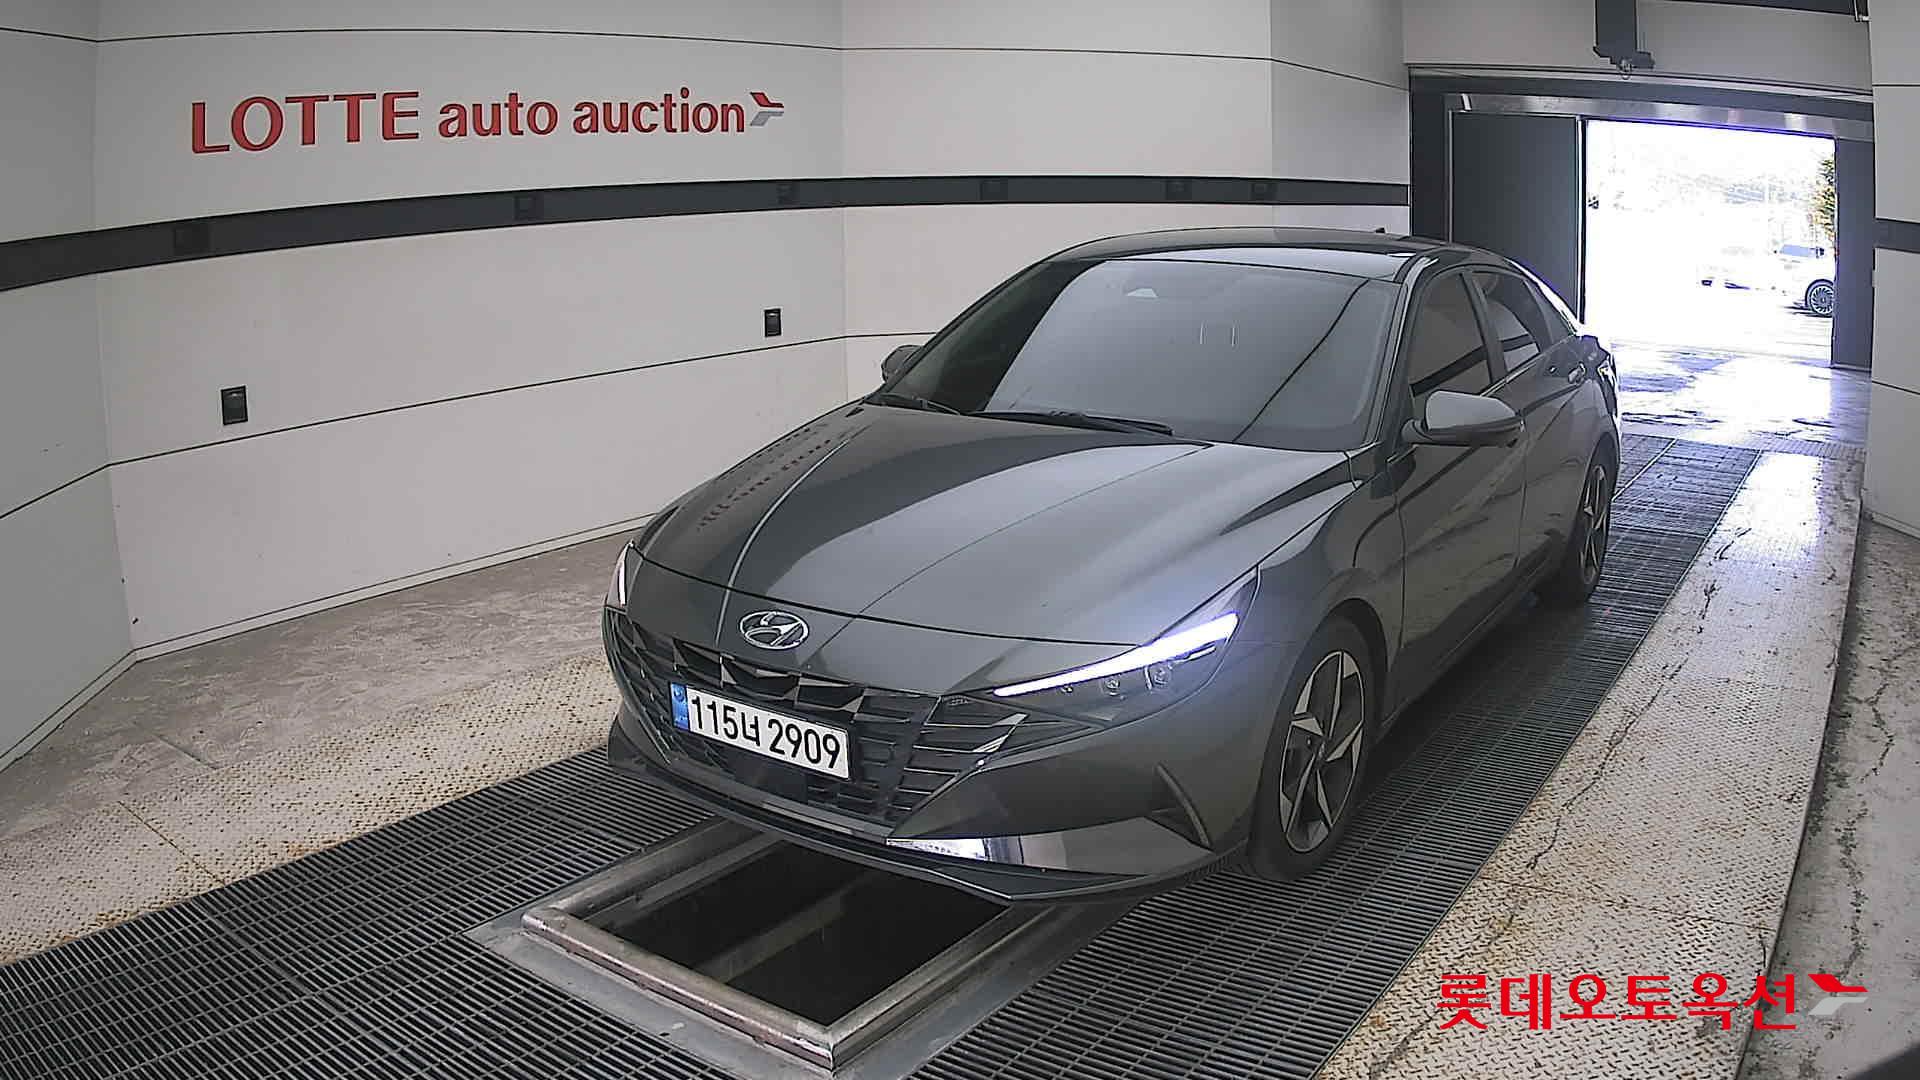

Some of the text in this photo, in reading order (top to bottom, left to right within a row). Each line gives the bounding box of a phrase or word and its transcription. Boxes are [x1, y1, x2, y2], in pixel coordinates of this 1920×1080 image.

[192, 87, 745, 154] LOTTE auto auction
[692, 695, 841, 769] 115너 2909
